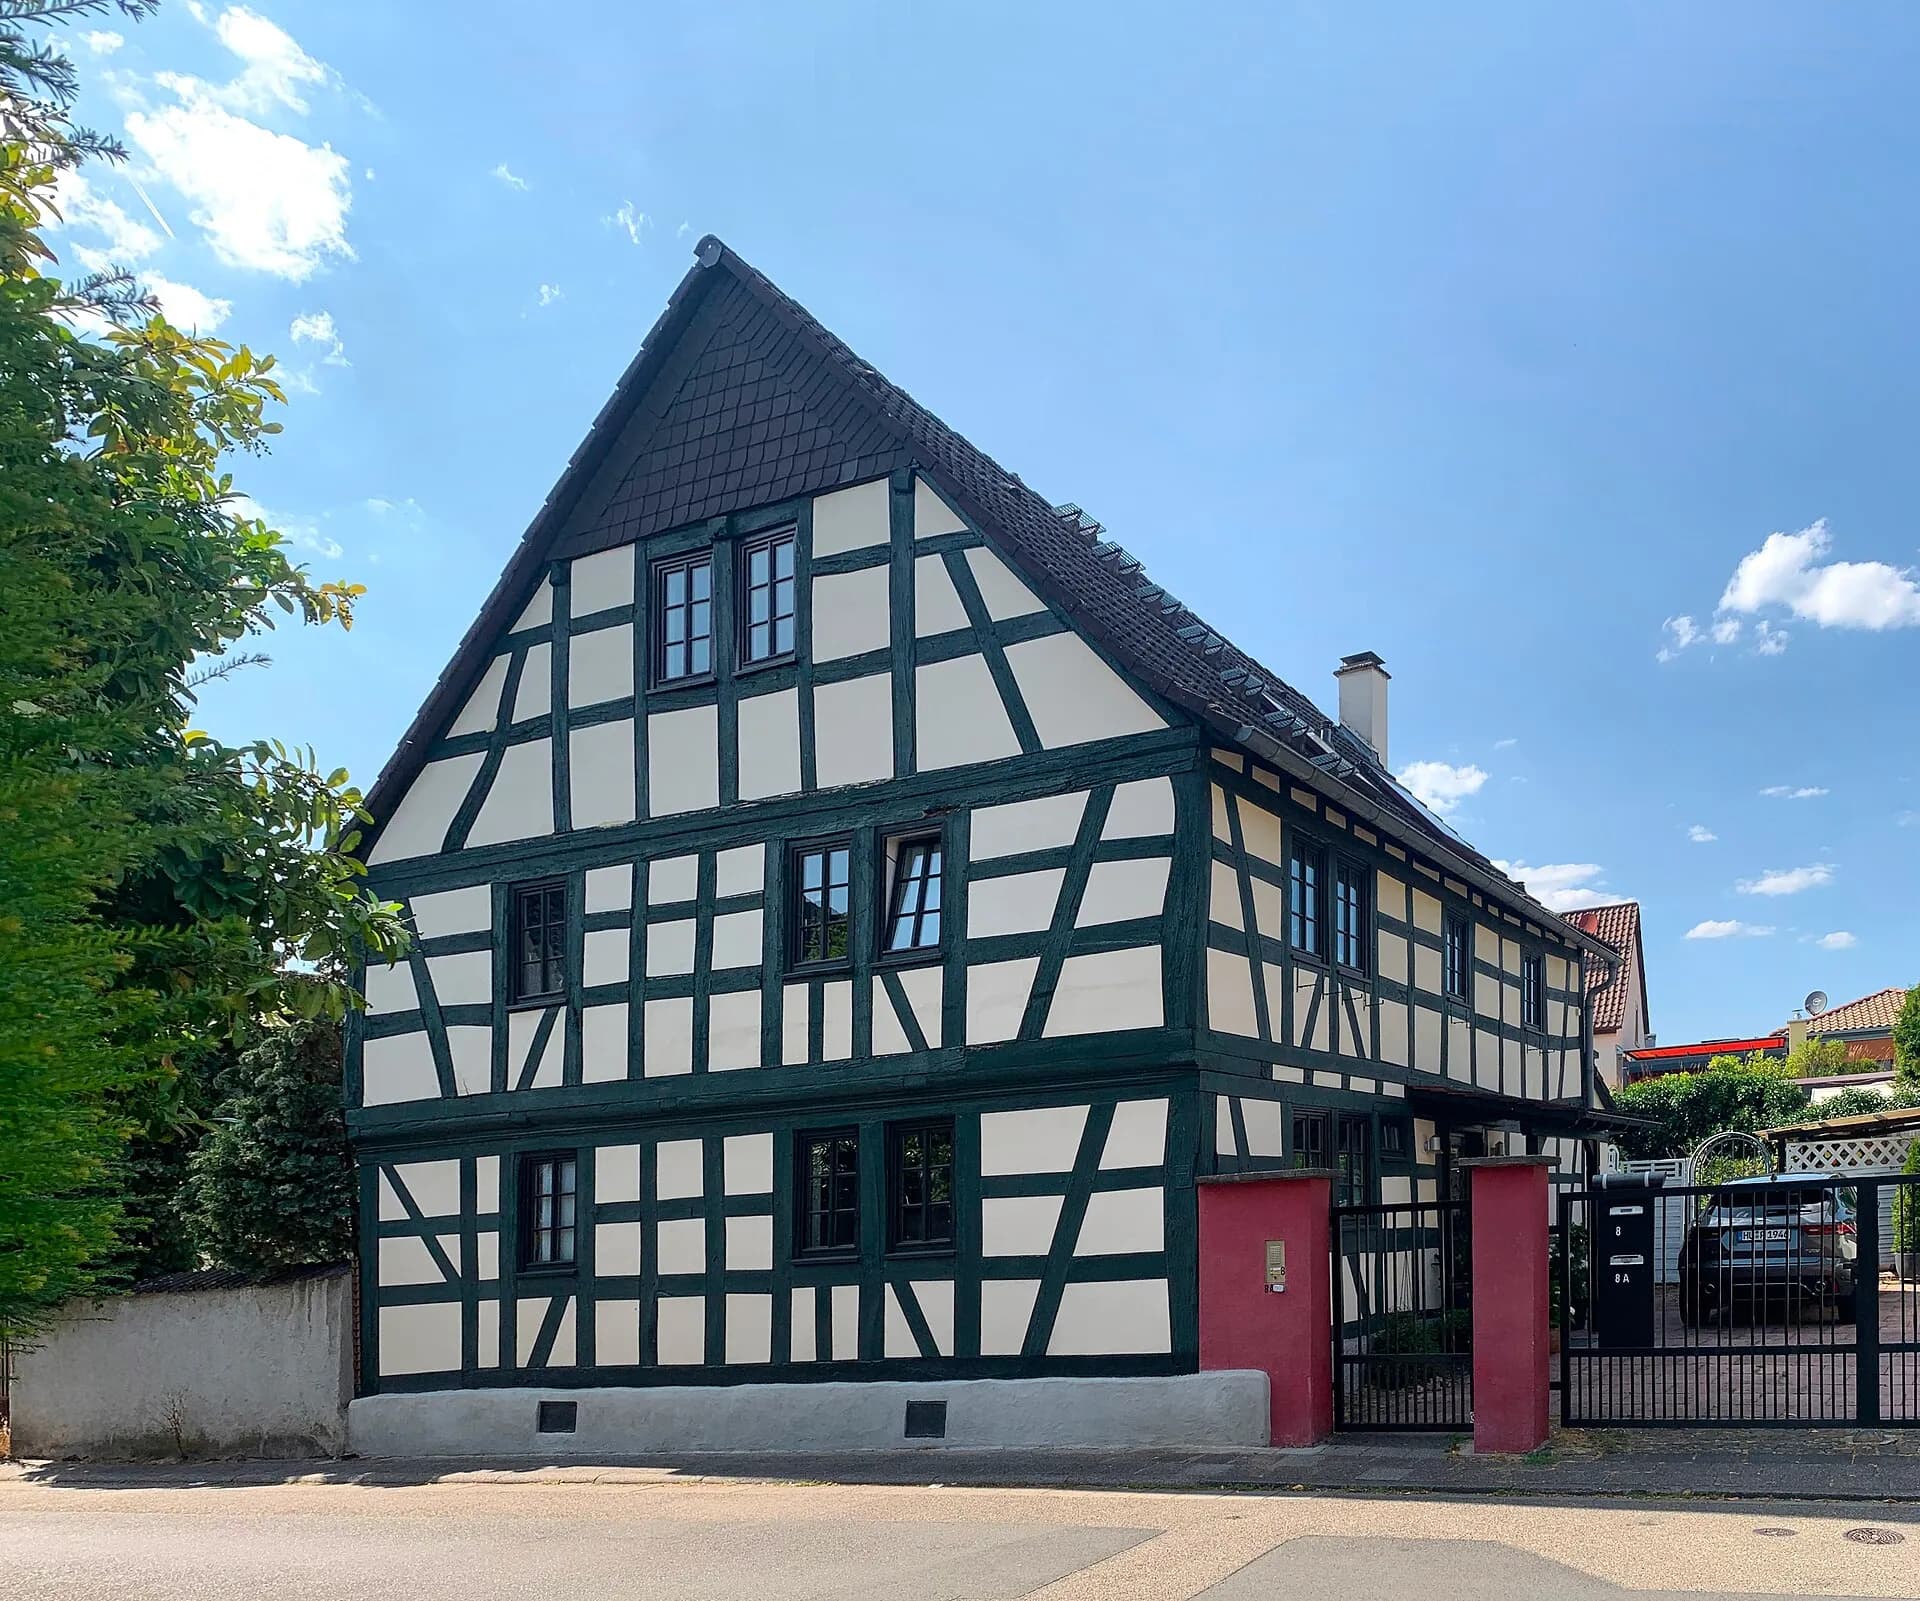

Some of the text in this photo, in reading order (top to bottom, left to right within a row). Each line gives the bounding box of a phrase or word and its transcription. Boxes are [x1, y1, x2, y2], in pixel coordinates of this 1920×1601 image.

[1615, 1226, 1621, 1236] 8
[1615, 1273, 1630, 1283] 8 A
